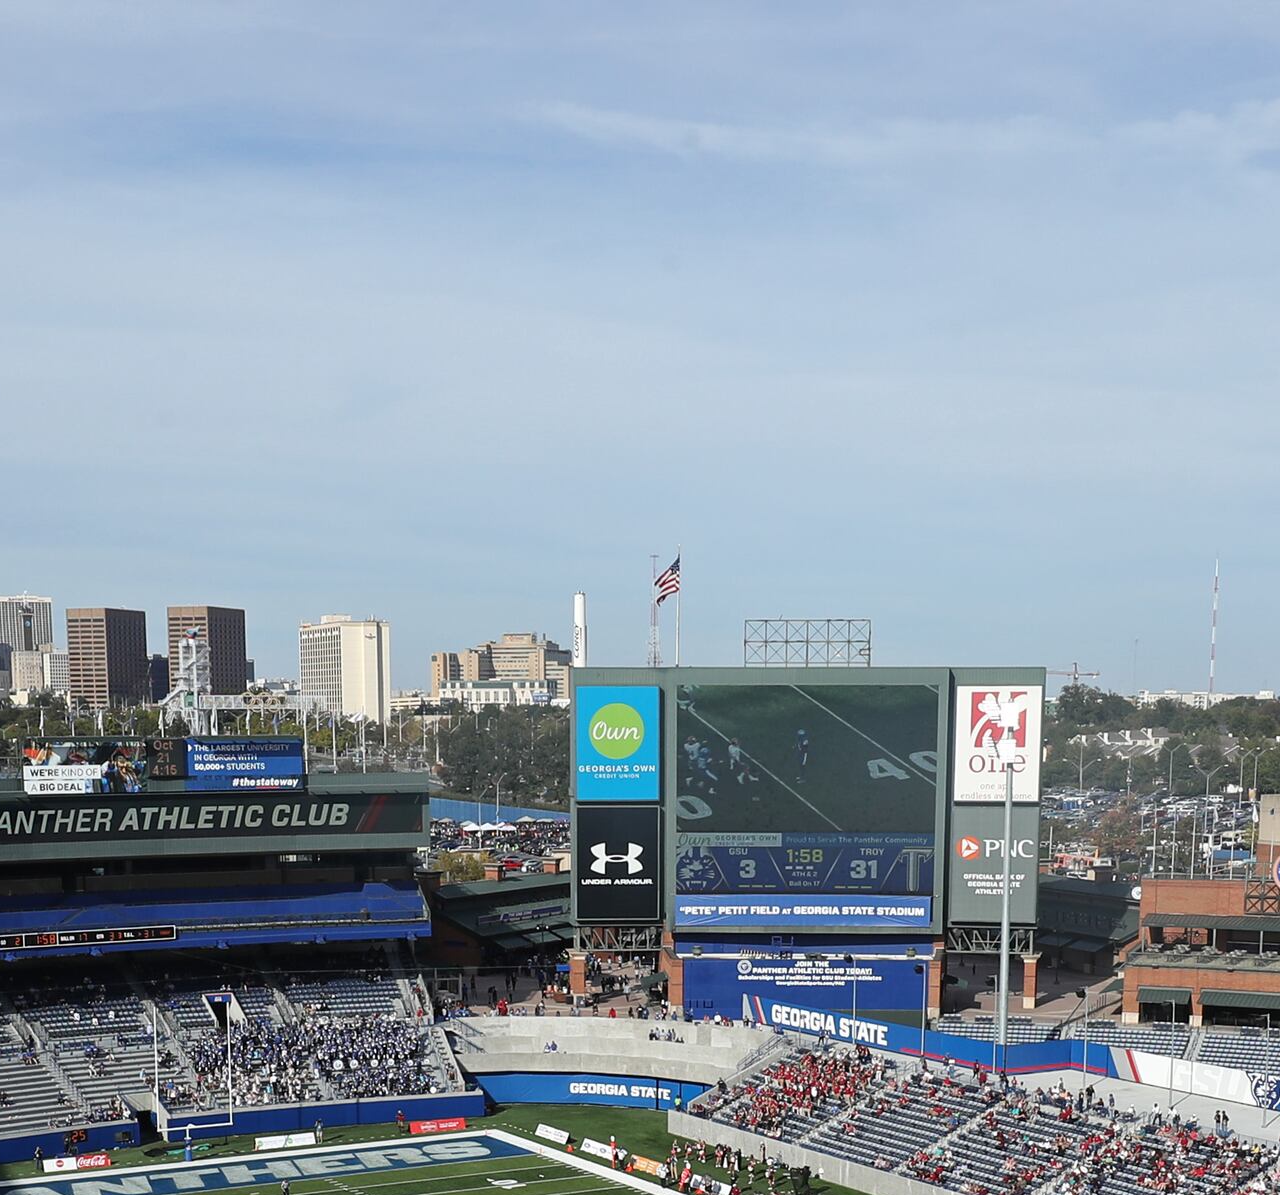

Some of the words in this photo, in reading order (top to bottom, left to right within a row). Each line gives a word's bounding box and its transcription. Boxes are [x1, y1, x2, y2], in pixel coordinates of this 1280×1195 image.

[592, 720, 641, 741] Own
[153, 740, 173, 751] Oct
[194, 744, 210, 752] THE
[156, 752, 170, 763] 21
[30, 768, 60, 778] WE'RE
[61, 768, 84, 777] KIND
[86, 768, 98, 776] OF
[152, 764, 178, 776] 4:15
[194, 764, 225, 772] 50,000+
[578, 764, 630, 773] GEORGIA'S
[632, 764, 656, 773] OWN
[30, 784, 38, 792] A
[39, 784, 56, 792] BIG
[57, 784, 82, 792] DEAL
[232, 777, 300, 788] #thestateway
[118, 804, 264, 832] ATHLETIC
[271, 802, 350, 828] CLUB
[884, 836, 928, 845] Community
[728, 848, 748, 856] GSU
[786, 848, 824, 863] 1:58
[860, 848, 885, 856] TROY
[739, 860, 756, 878] 3
[850, 860, 878, 879] 31
[750, 907, 780, 915] FIELD
[793, 907, 840, 915] GEORGIA
[842, 907, 874, 915] STATE
[876, 908, 925, 916] STADIUM
[37, 934, 56, 944] 1:58
[143, 929, 154, 938] 31
[772, 1004, 837, 1036] GEORGIA
[839, 1018, 888, 1046] STATE
[570, 1082, 628, 1097] GEORGIA
[630, 1085, 672, 1101] STATE
[72, 1130, 86, 1141] 25
